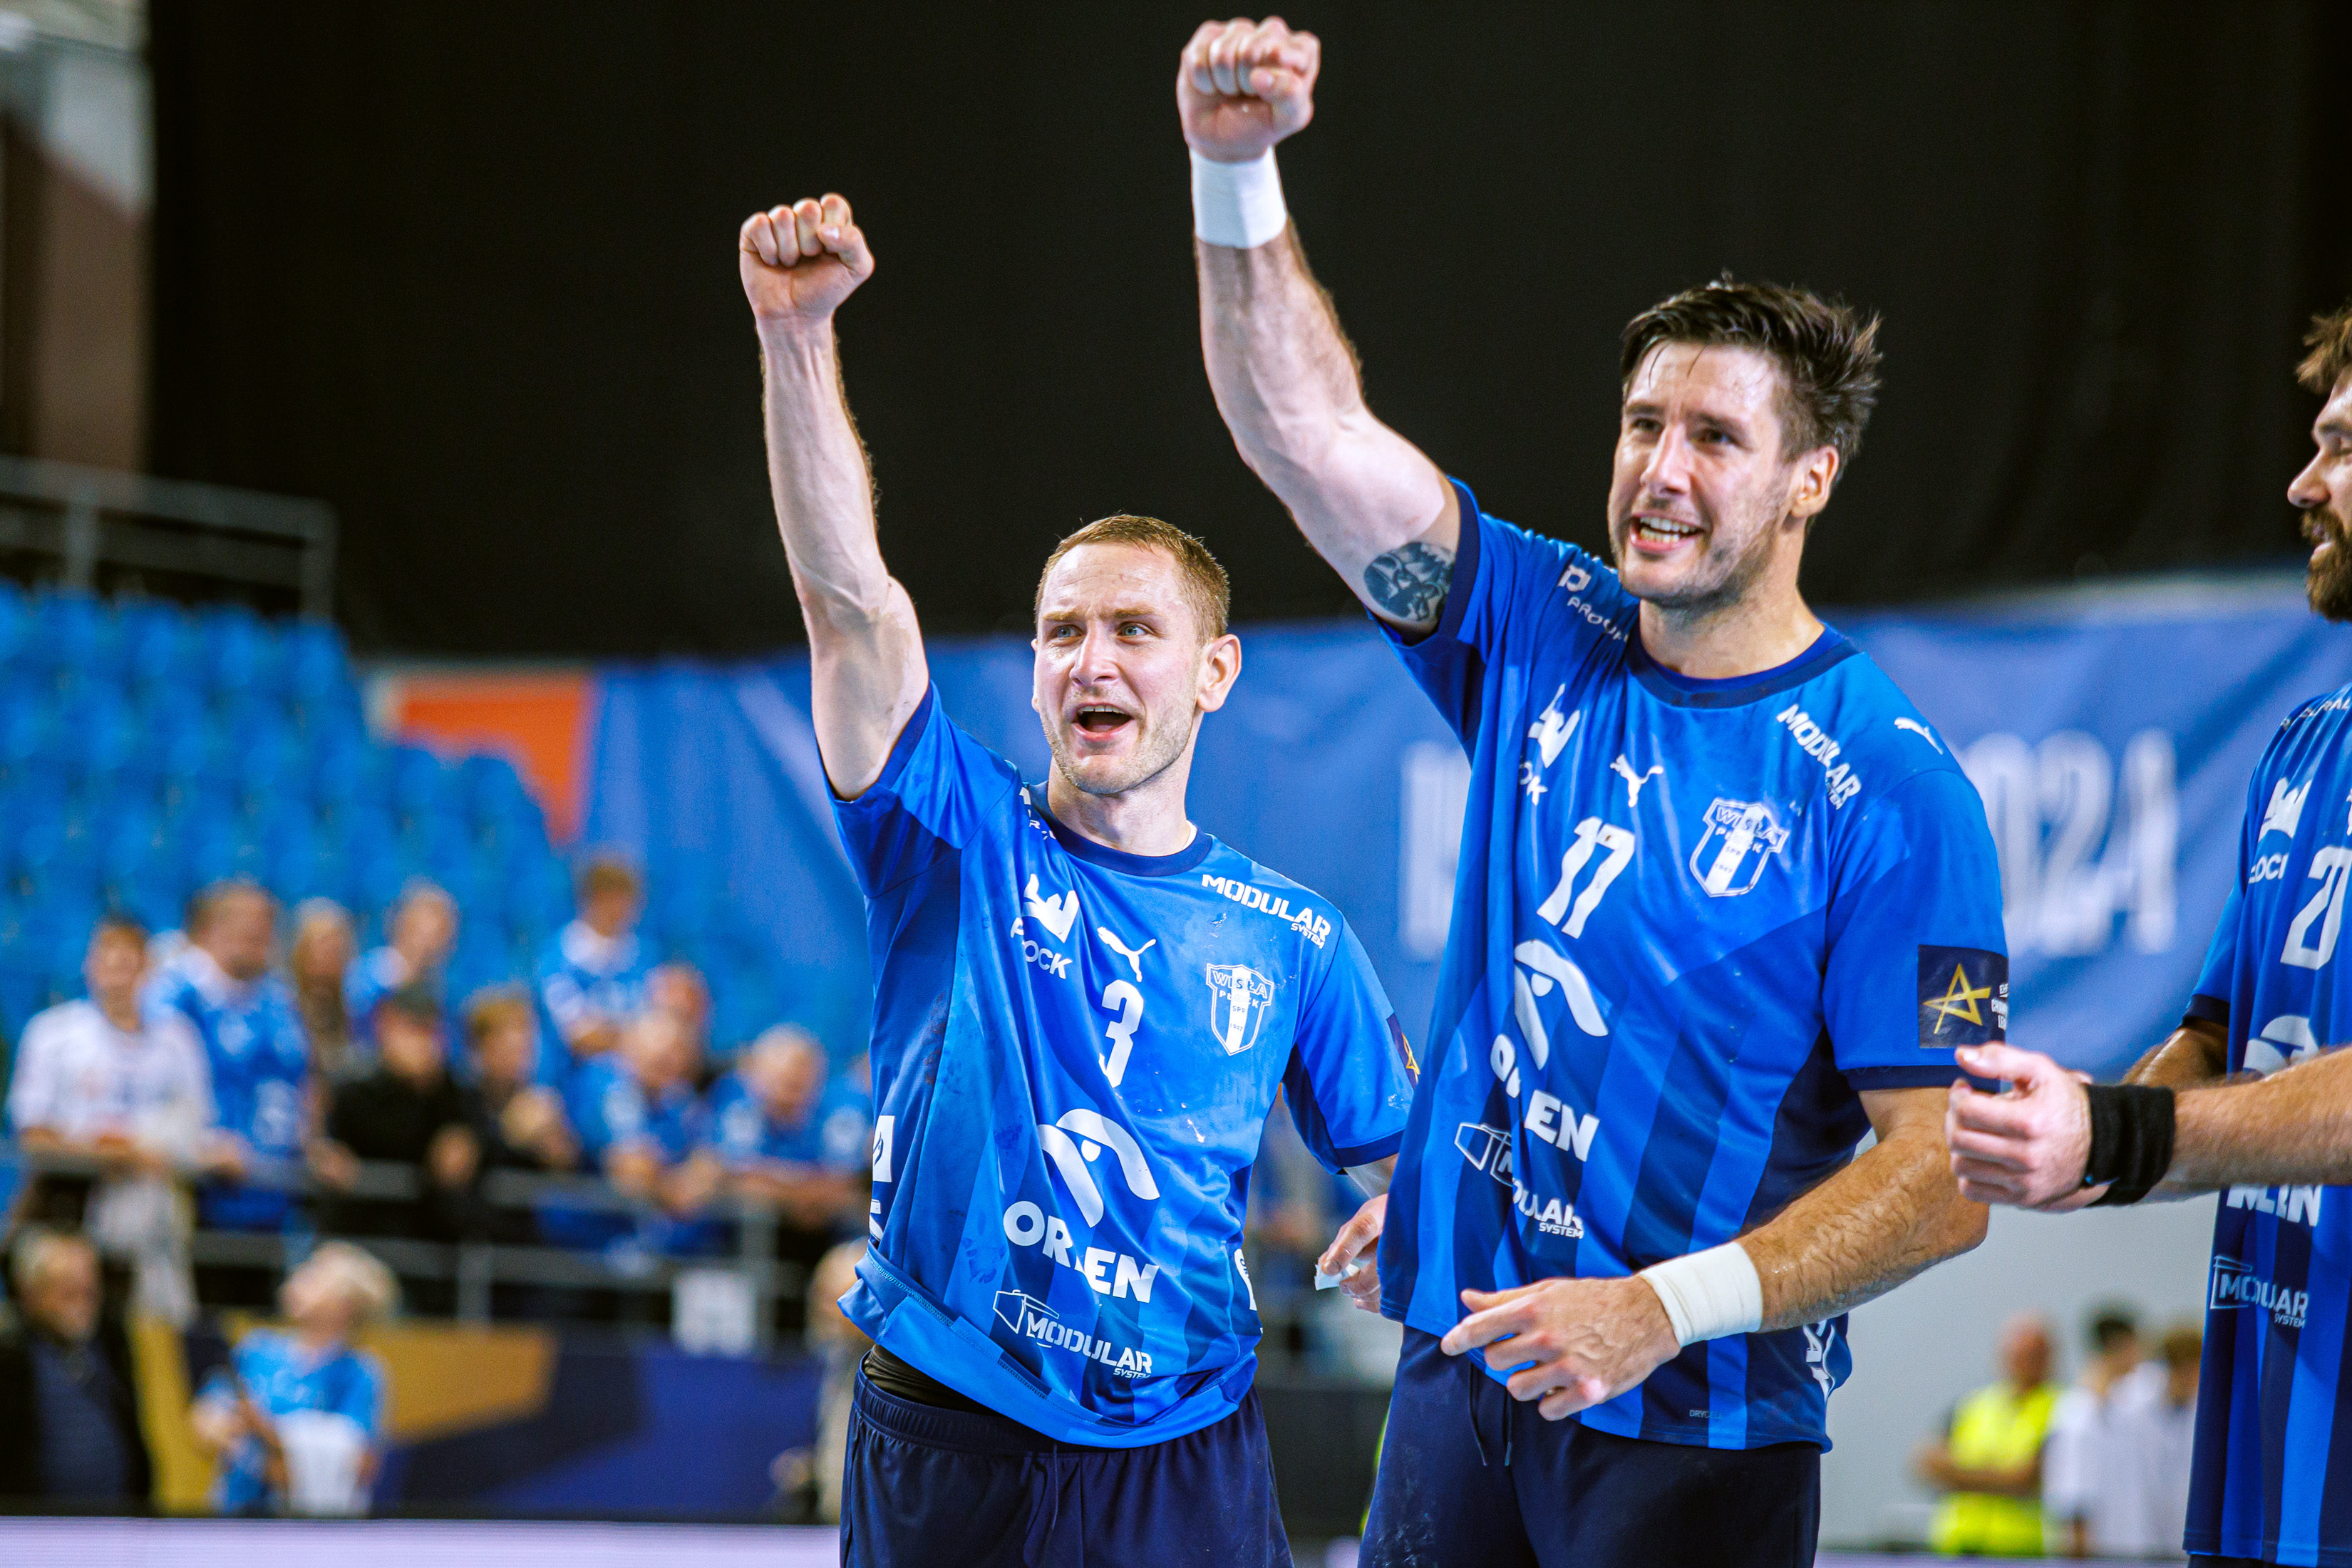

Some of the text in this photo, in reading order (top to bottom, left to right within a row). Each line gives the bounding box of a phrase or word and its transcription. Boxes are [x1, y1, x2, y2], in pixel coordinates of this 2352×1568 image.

[1202, 875, 1331, 942] MODULAR
[1537, 816, 1635, 939] 17
[1011, 917, 1073, 979] POCK
[1291, 923, 1325, 949] SYSTEM
[1212, 971, 1267, 999] WISŁA
[1099, 980, 1144, 1088] 3
[1490, 1033, 1599, 1162] OEN
[1004, 1201, 1159, 1303] OREN
[1539, 1223, 1584, 1239] SYSTEM
[1026, 1311, 1152, 1373] MODULAR
[1113, 1368, 1150, 1379] SYSTEM
